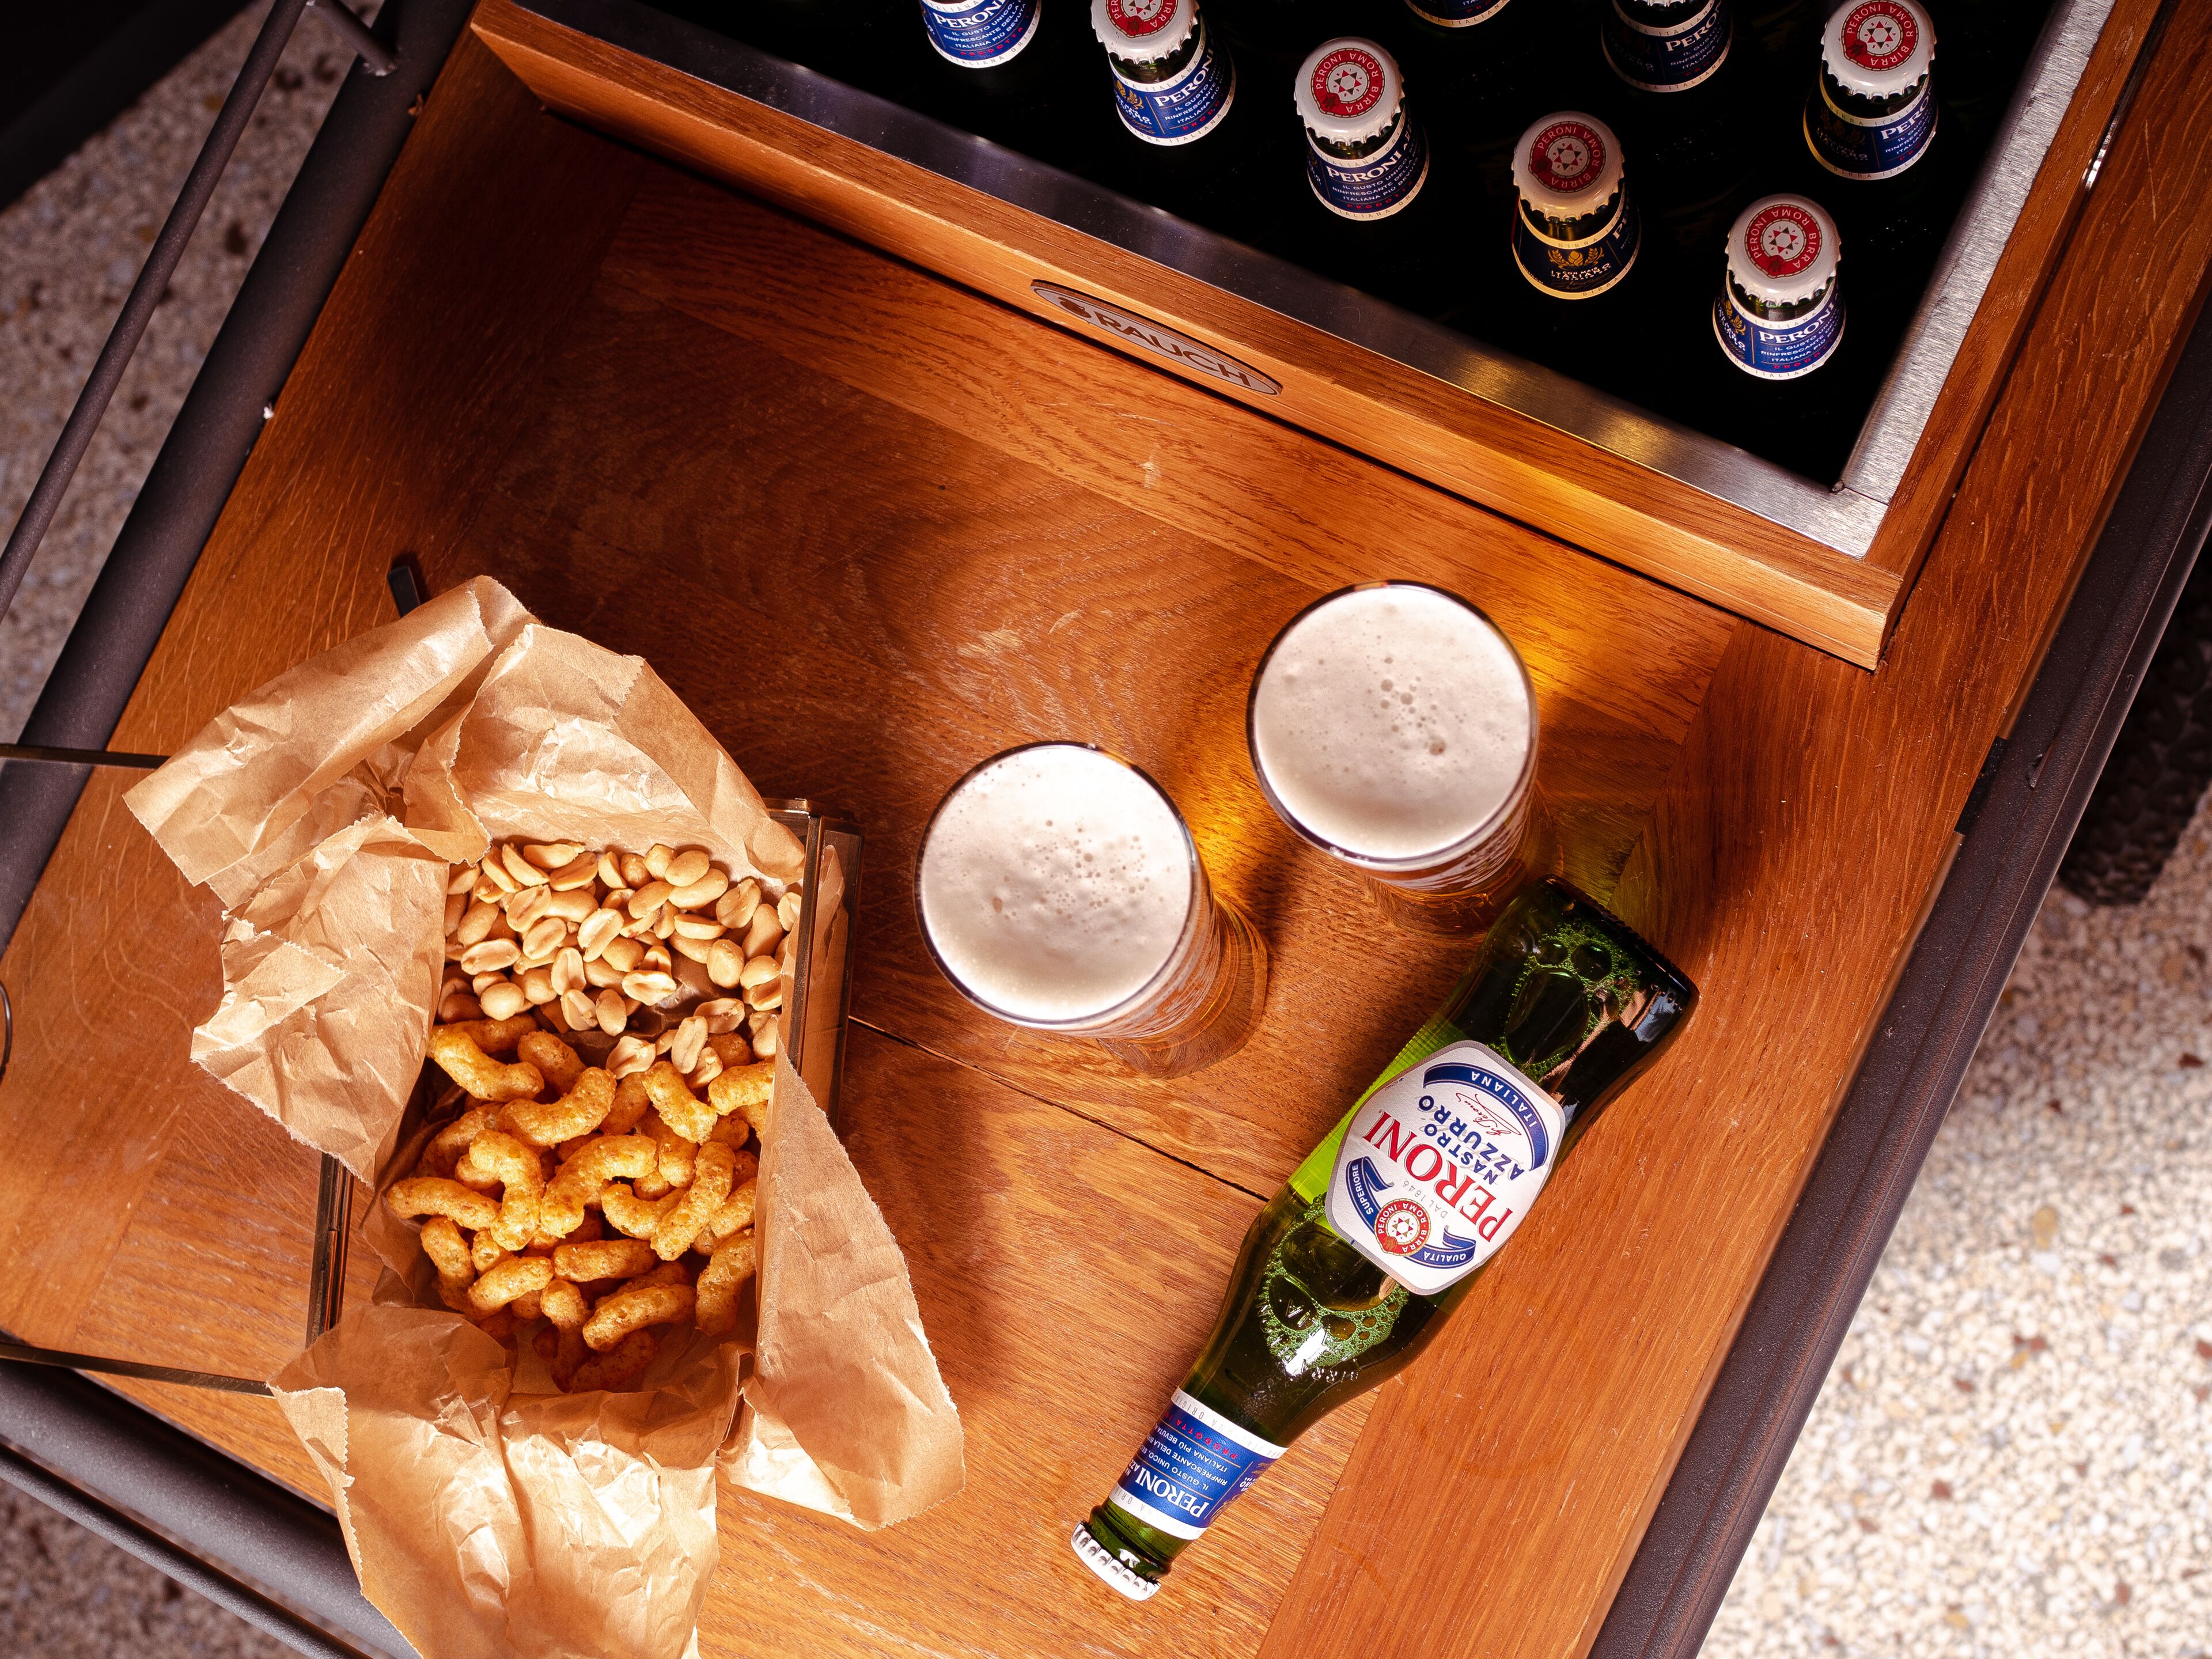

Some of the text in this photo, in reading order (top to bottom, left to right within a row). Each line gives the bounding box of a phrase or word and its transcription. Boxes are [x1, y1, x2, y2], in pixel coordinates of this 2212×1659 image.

[932, 0, 1006, 28] PERON
[961, 25, 990, 36] GUSTO
[1111, 0, 1173, 28] PER IRRA
[1665, 0, 1721, 52] PERO
[943, 26, 1002, 43] RINFRESCANTE
[955, 40, 991, 48] ITALIANA
[1846, 3, 1914, 66] PERONI ROMA BIRRA
[1153, 47, 1214, 107] PERONI
[1316, 52, 1379, 113] PERONI ROMA BIRRA
[1164, 82, 1216, 120] RINFRESCANTE
[1184, 84, 1209, 107] GUSTO
[1880, 84, 1932, 140] PERO
[1177, 101, 1211, 124] ITALIANA
[1325, 150, 1403, 183] PERONI
[1537, 126, 1601, 188] PERONI ROMA BIRRA
[1332, 181, 1393, 196] RINFRESCANTE
[1353, 180, 1383, 191] GUSTO
[1558, 237, 1599, 249] BIRRA
[1749, 209, 1817, 269] PERONI ROMA BIRRA
[1758, 303, 1835, 344] PERONI
[1096, 312, 1252, 387] RAUCH
[1760, 335, 1824, 357] RINFRESCANTE
[1771, 350, 1812, 362] ITALIANA
[1786, 335, 1816, 351] GUSTO
[1471, 1071, 1537, 1128] ITALIANA
[1418, 1094, 1525, 1181] AZZURRO
[1424, 1123, 1499, 1185] NASTRO
[1351, 1164, 1374, 1215] SUPERIORE
[1362, 1111, 1513, 1243] PERONI
[1403, 1179, 1448, 1219] DAL 1846
[1377, 1202, 1427, 1253] PERONI ROMA BIRRA
[1422, 1250, 1467, 1263] QUALITÀ
[1155, 1438, 1171, 1456] DELLA
[1157, 1426, 1178, 1444] BEVUTA
[1175, 1418, 1238, 1460] PRODOTTA
[1178, 1441, 1192, 1453] PIÙ
[1171, 1451, 1228, 1486] RINFRESCANTE
[1171, 1466, 1200, 1486] GUSTO
[1194, 1449, 1228, 1473] ITALIANA
[1135, 1468, 1210, 1518] PERONI
[1202, 1482, 1209, 1491] IL
